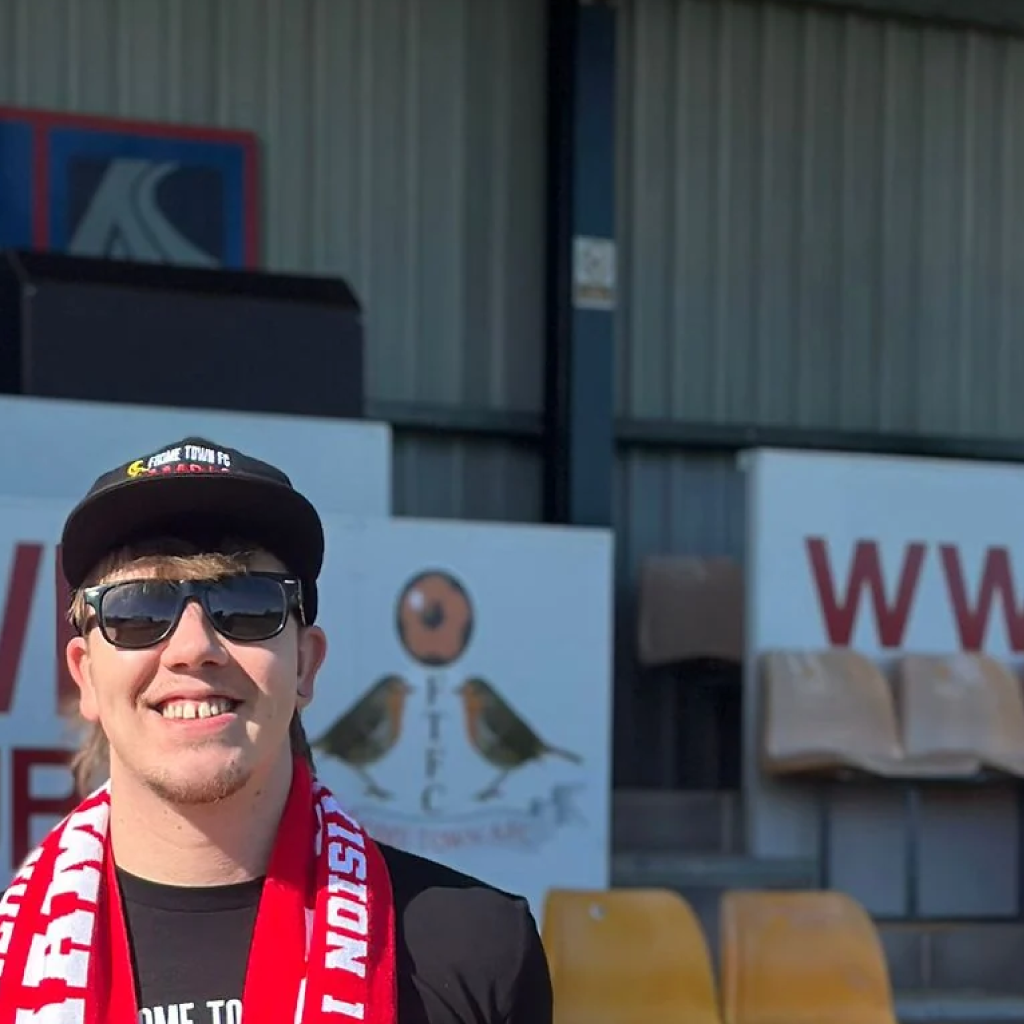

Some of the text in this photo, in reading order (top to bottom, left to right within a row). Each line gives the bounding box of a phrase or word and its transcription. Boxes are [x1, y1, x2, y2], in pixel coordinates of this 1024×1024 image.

[148, 445, 231, 467] FROME TOWN FC
